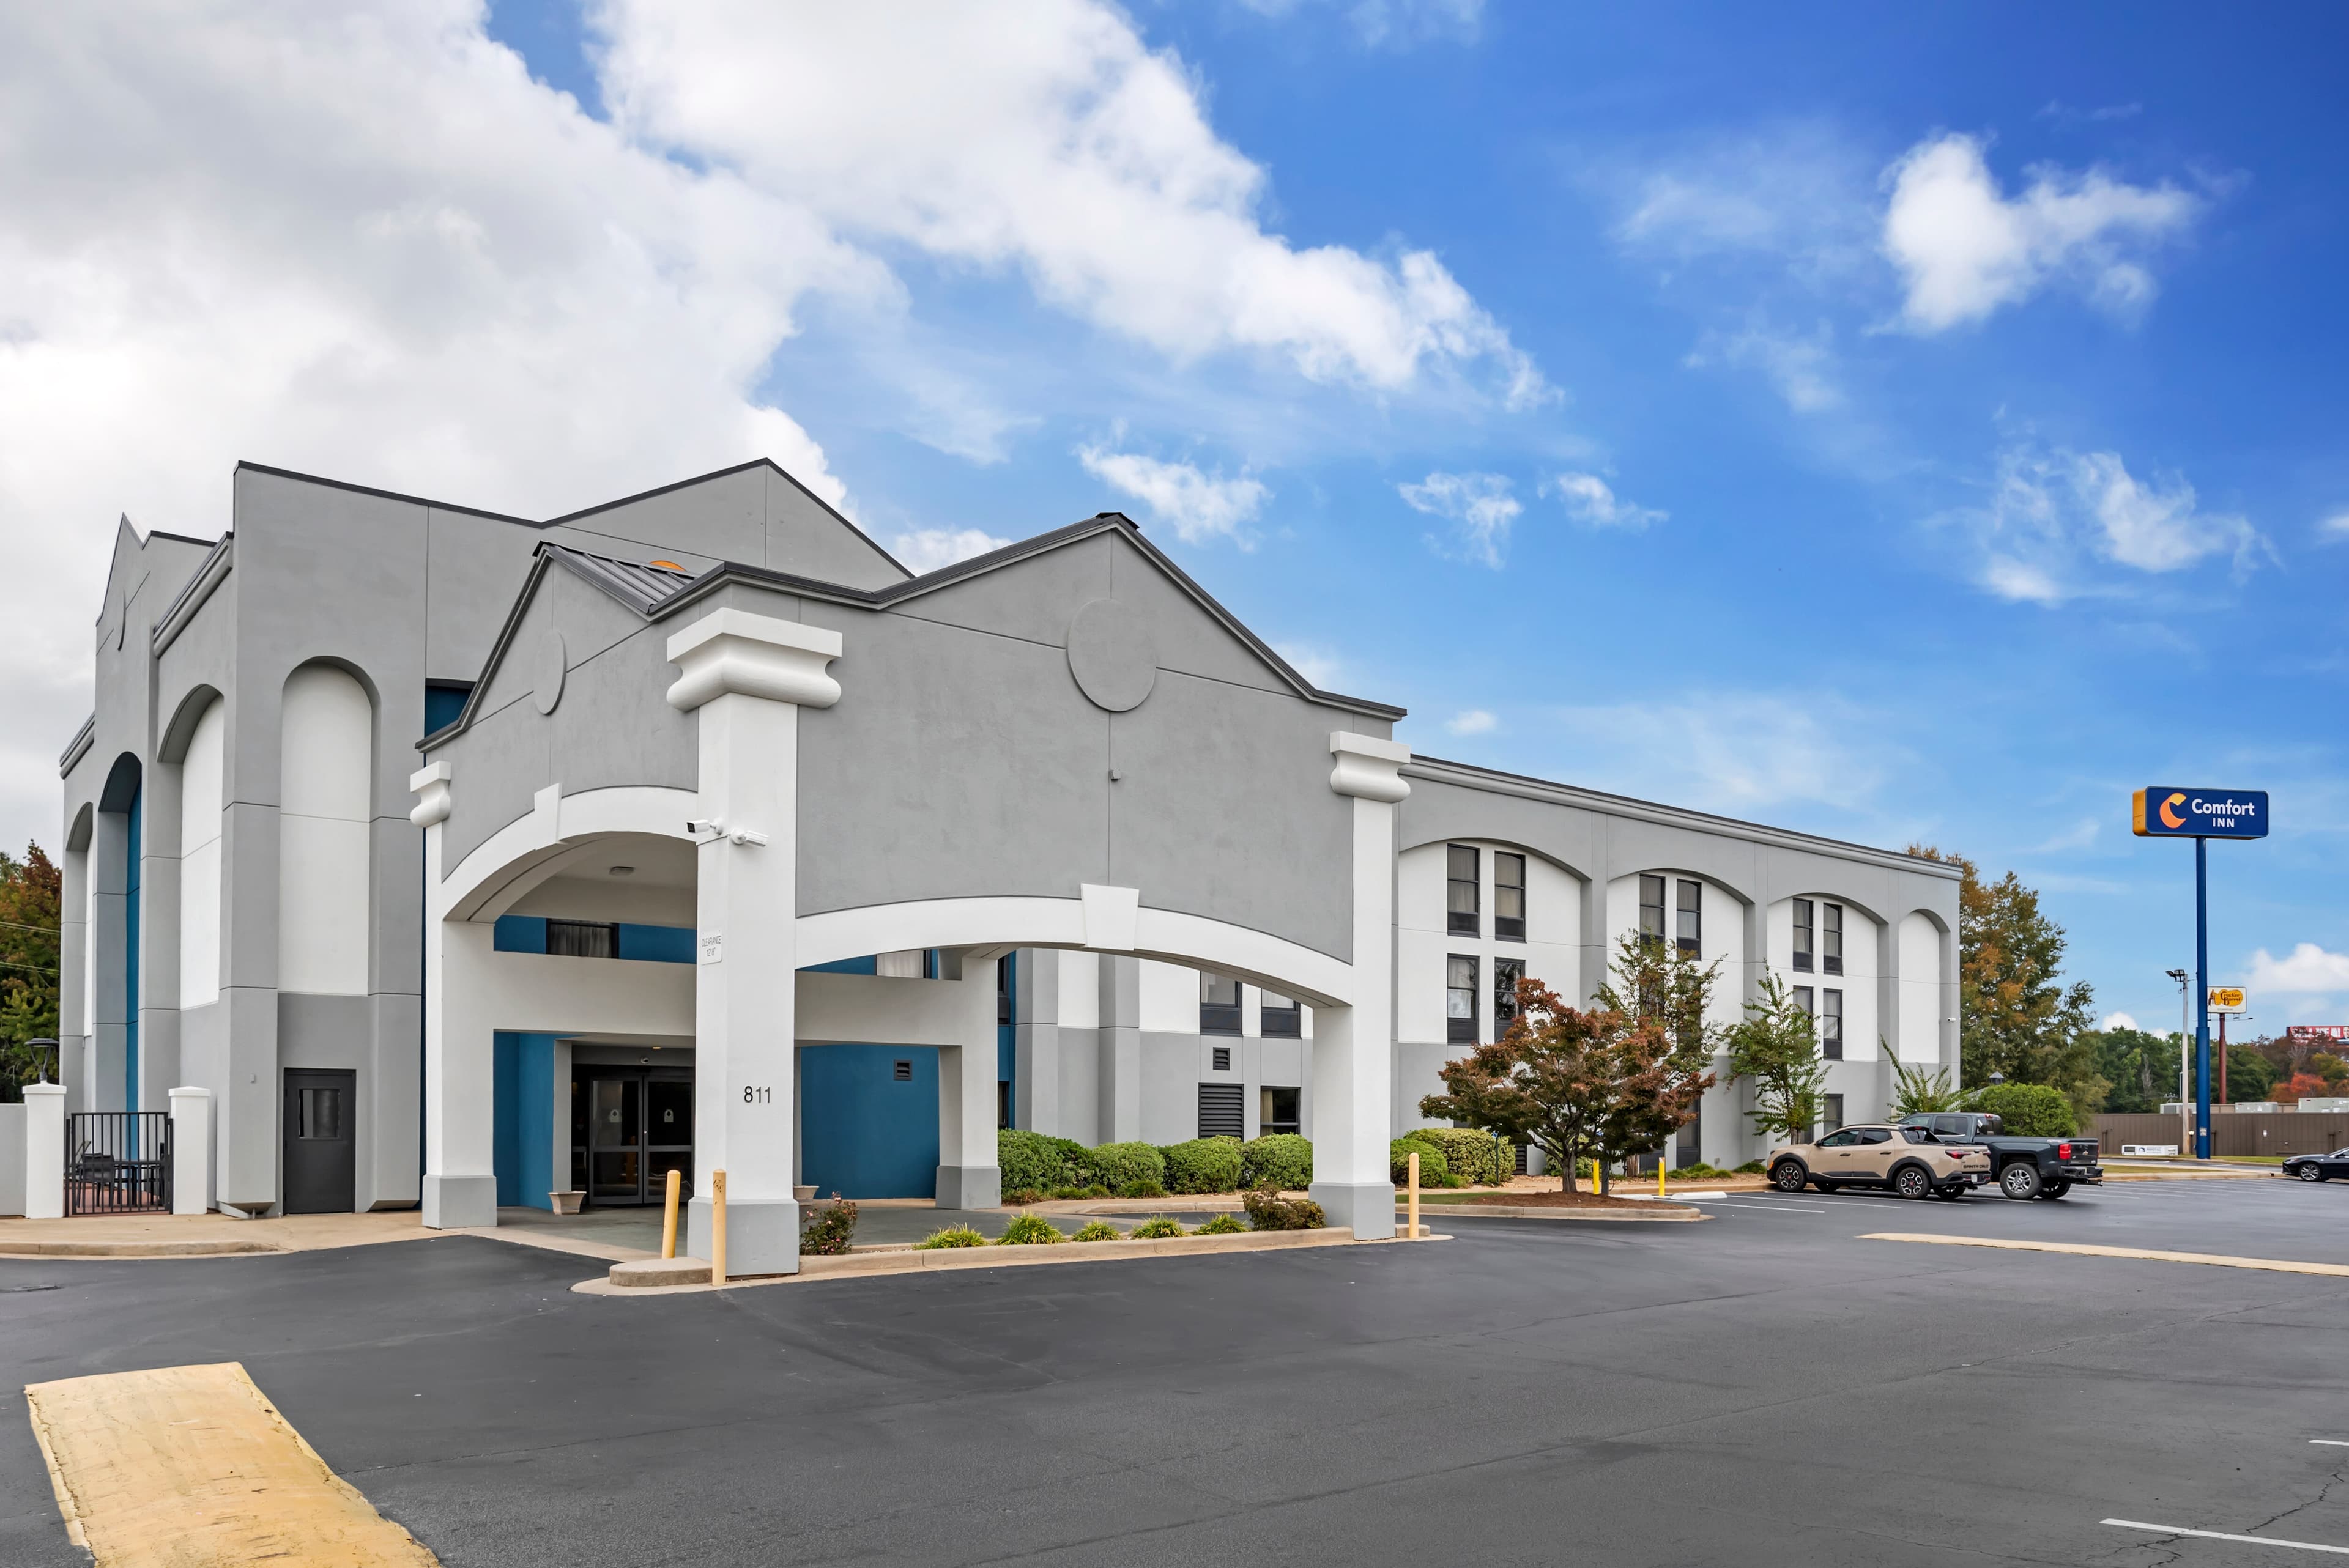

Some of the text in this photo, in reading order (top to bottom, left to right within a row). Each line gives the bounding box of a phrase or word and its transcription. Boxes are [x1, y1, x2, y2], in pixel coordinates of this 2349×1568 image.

[2192, 798, 2255, 816] Comfort
[2213, 817, 2235, 827] INN
[702, 936, 721, 947] CLEARANCE
[744, 1085, 771, 1104] 811
